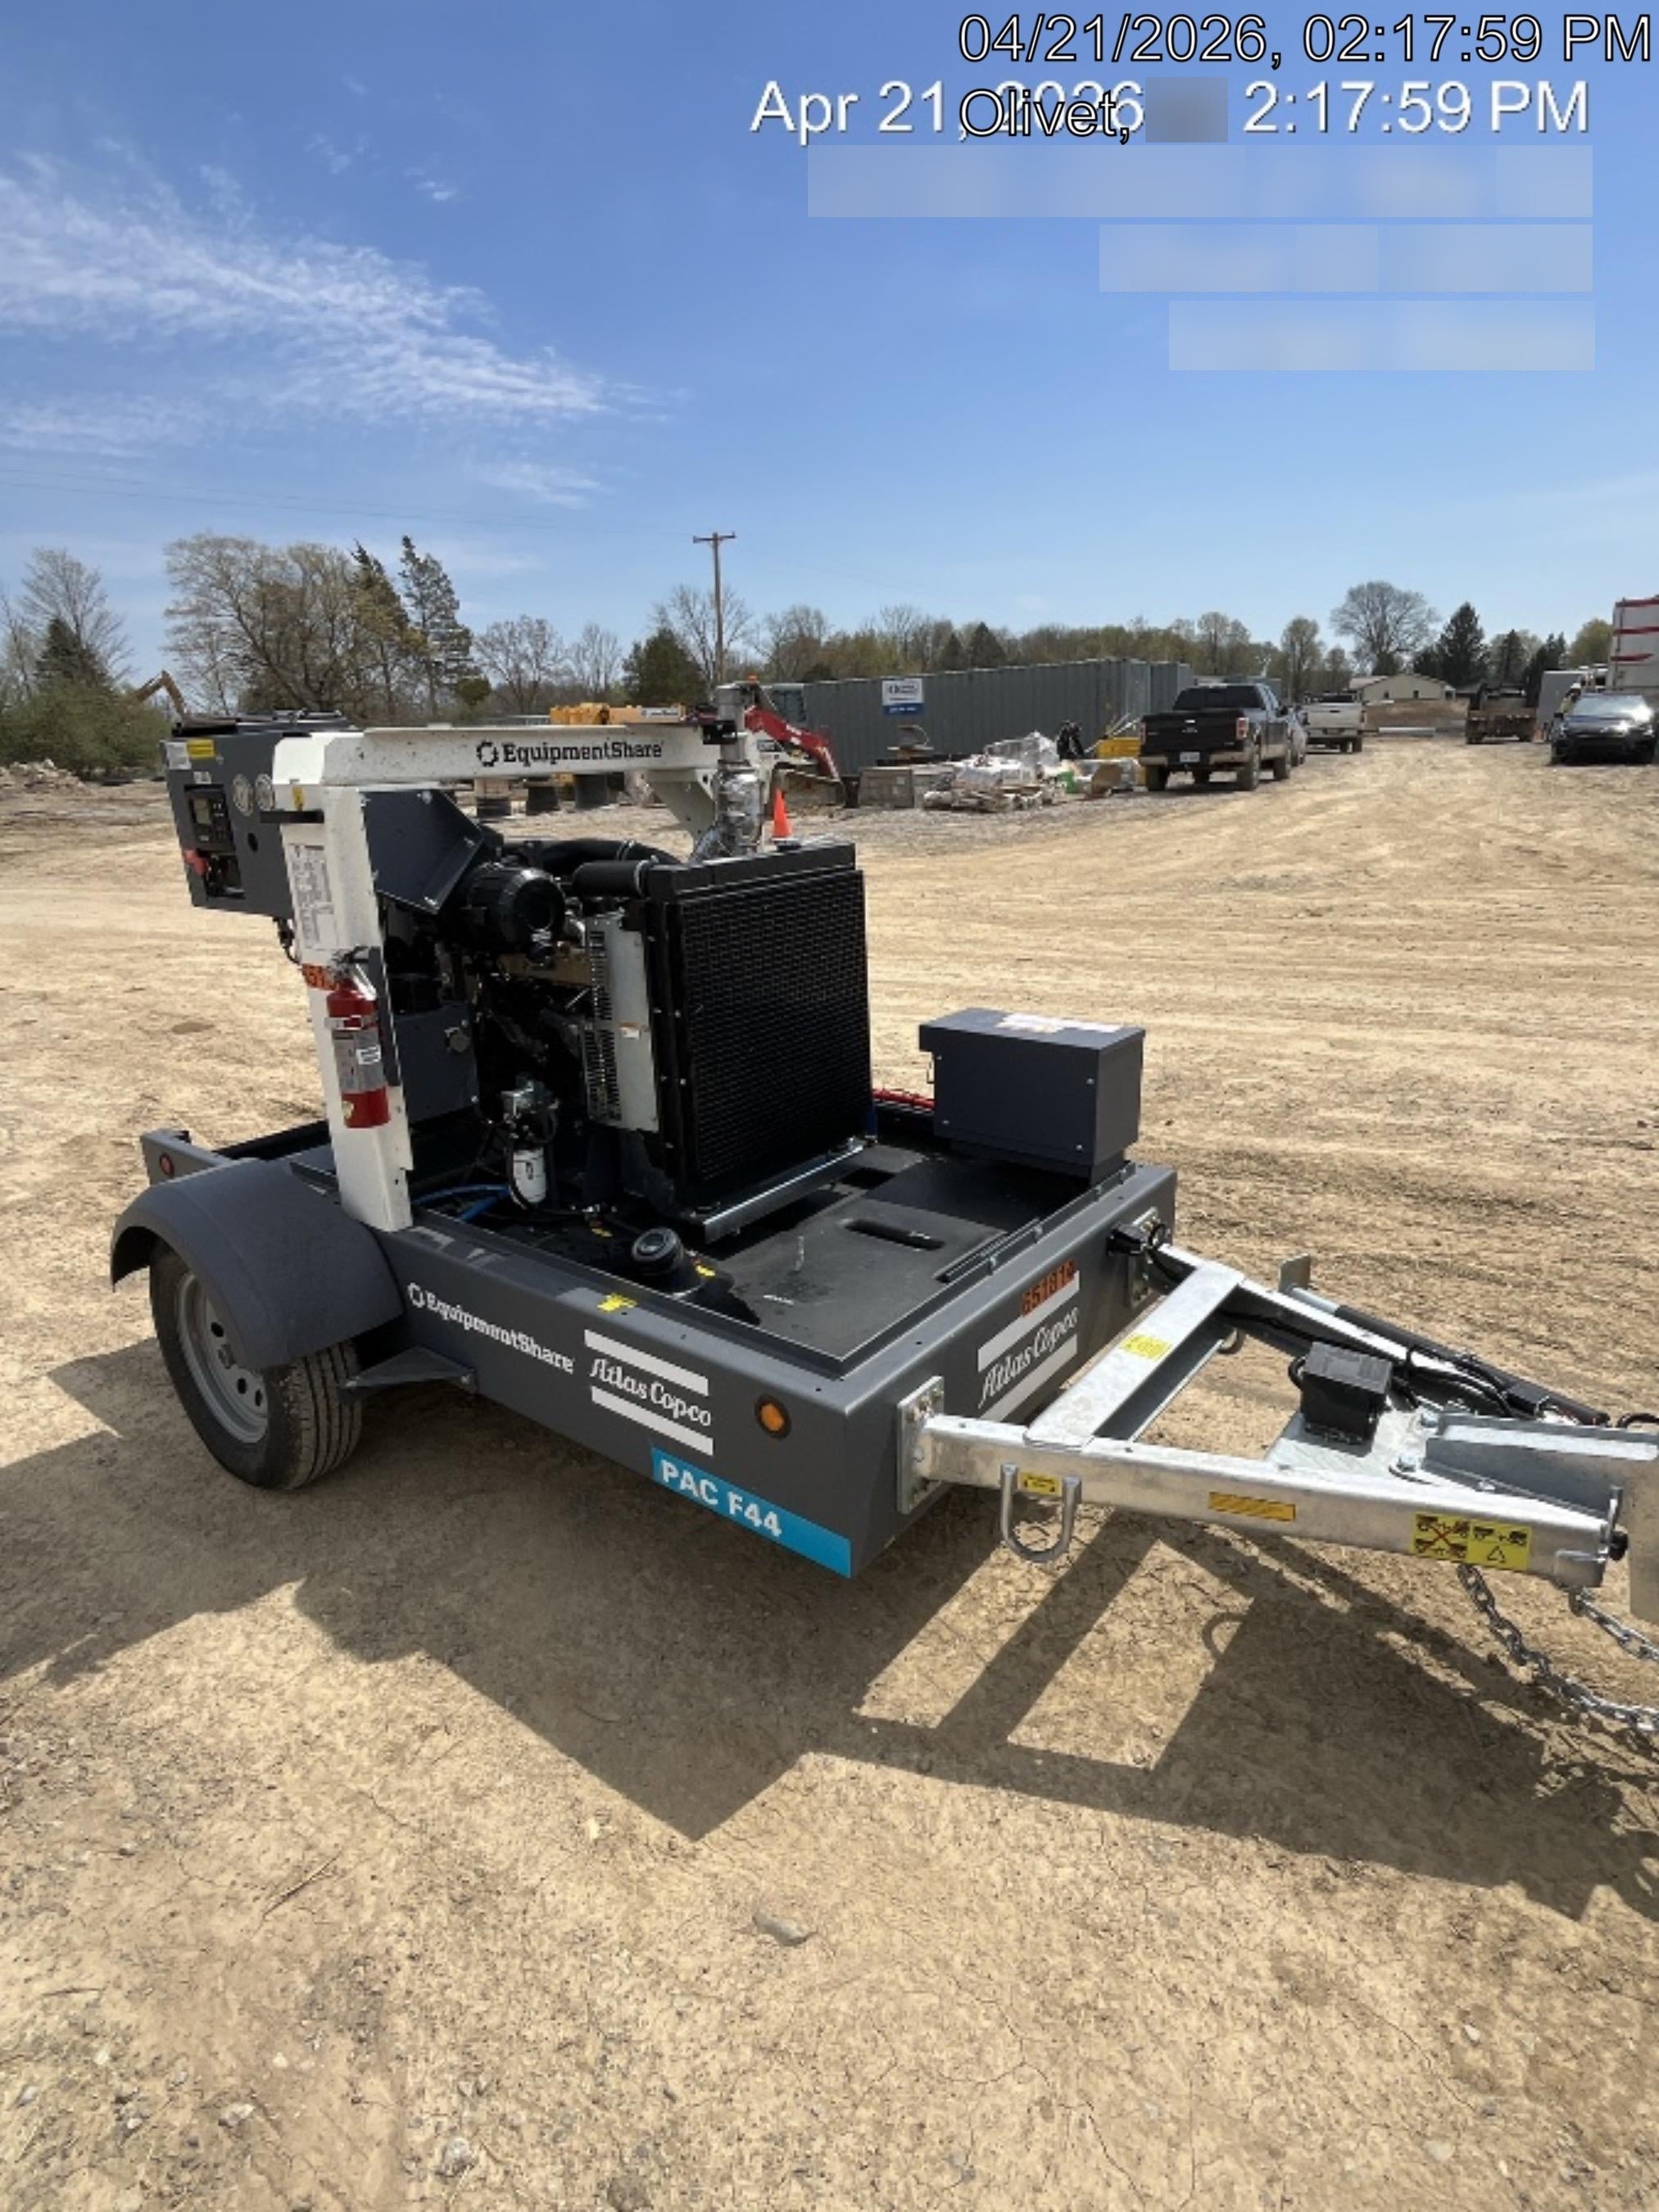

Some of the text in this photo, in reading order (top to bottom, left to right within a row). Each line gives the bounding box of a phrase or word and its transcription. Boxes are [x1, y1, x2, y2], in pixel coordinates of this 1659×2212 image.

[502, 741, 664, 767] EquipmentShare
[425, 1290, 574, 1375] EquipmentShare
[977, 1346, 1031, 1409] Atlas
[1034, 1306, 1079, 1358] Copco
[590, 1358, 712, 1426] Atlas Copco
[661, 1459, 783, 1538] PAC F44
